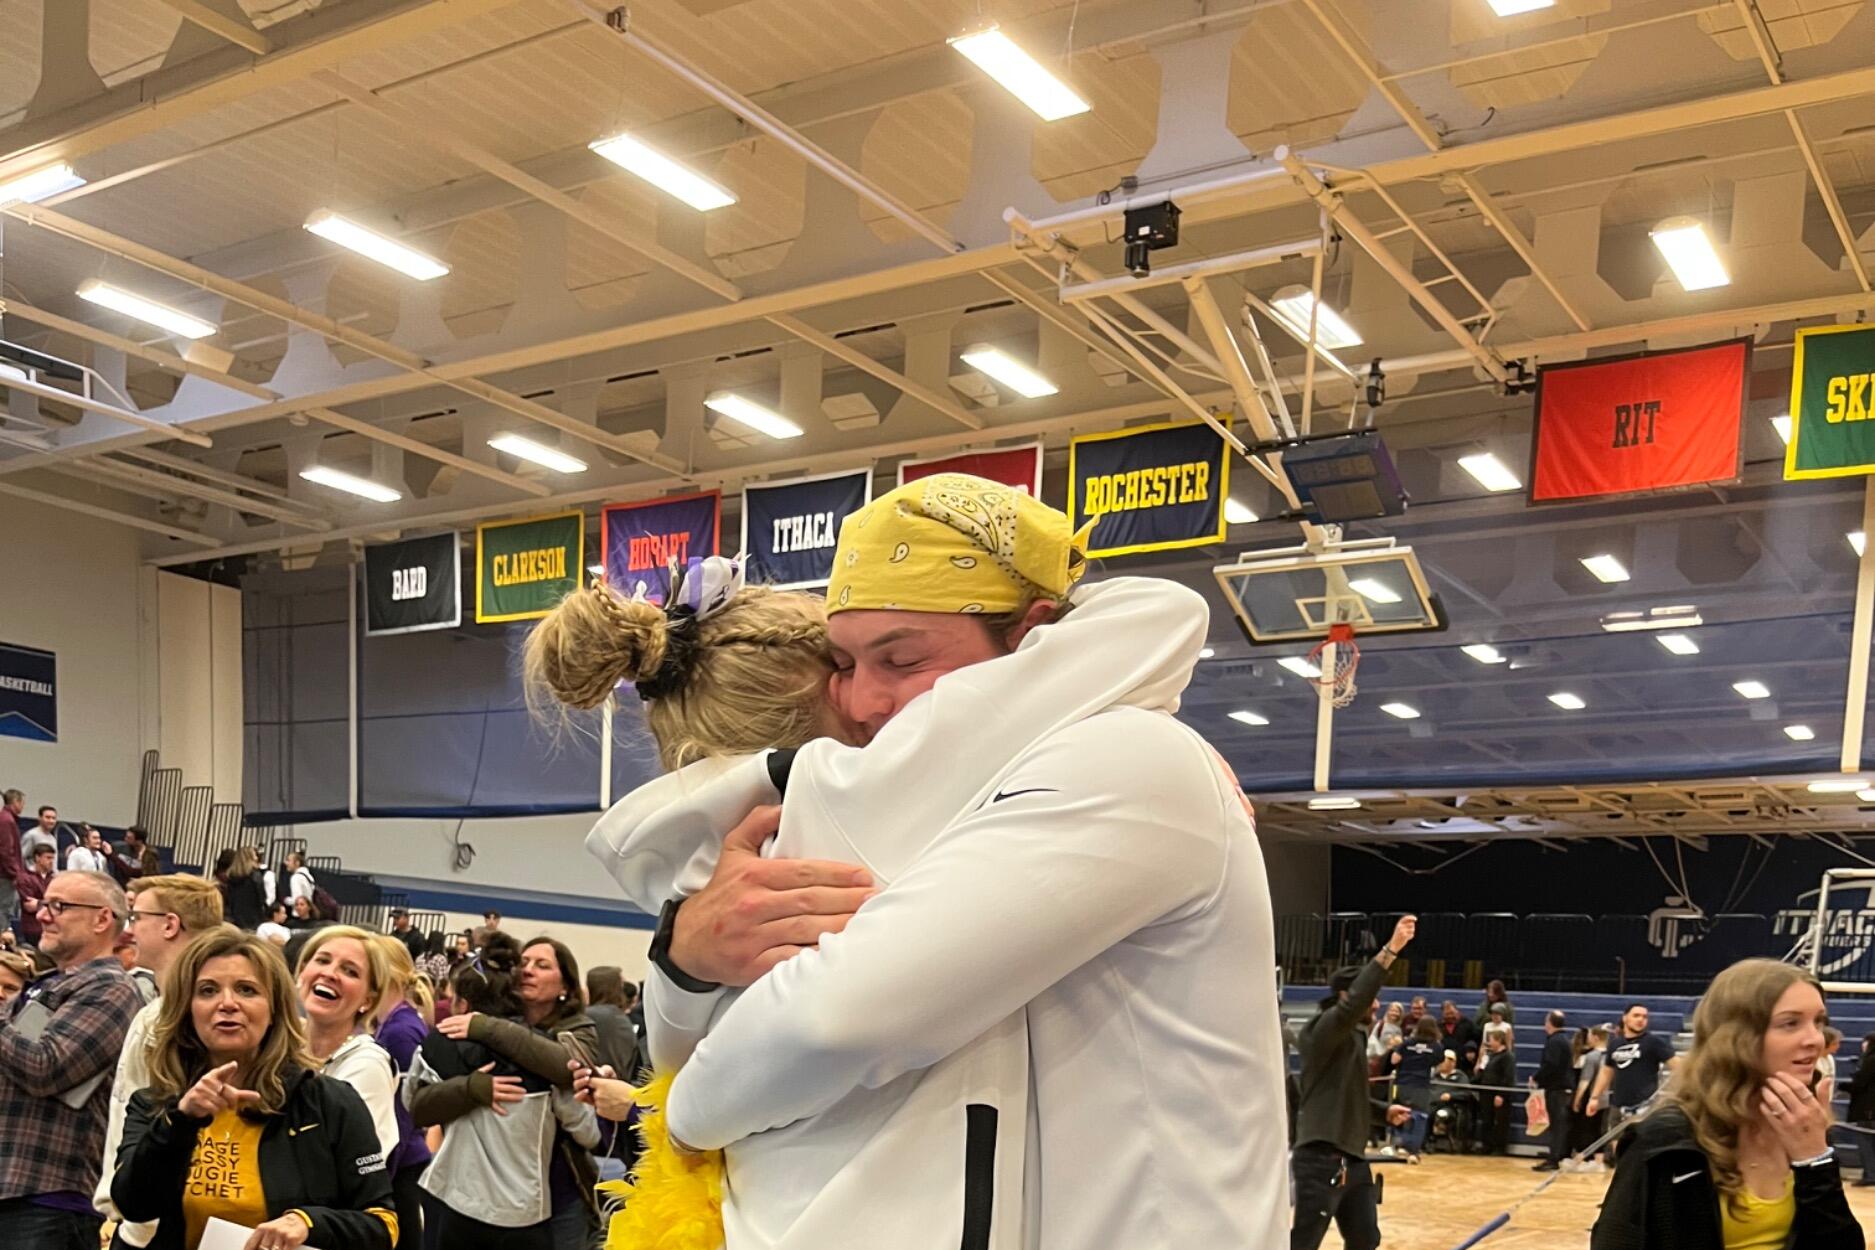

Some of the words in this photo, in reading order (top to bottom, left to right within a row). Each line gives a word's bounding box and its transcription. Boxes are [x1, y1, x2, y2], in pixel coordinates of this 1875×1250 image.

[1613, 401, 1661, 448] RIT
[1083, 461, 1210, 516] ROCHESTER
[772, 511, 836, 554] ITHACA
[392, 566, 427, 601] BARD
[493, 547, 567, 587] CLARKSON
[190, 1167, 239, 1184] UGIE
